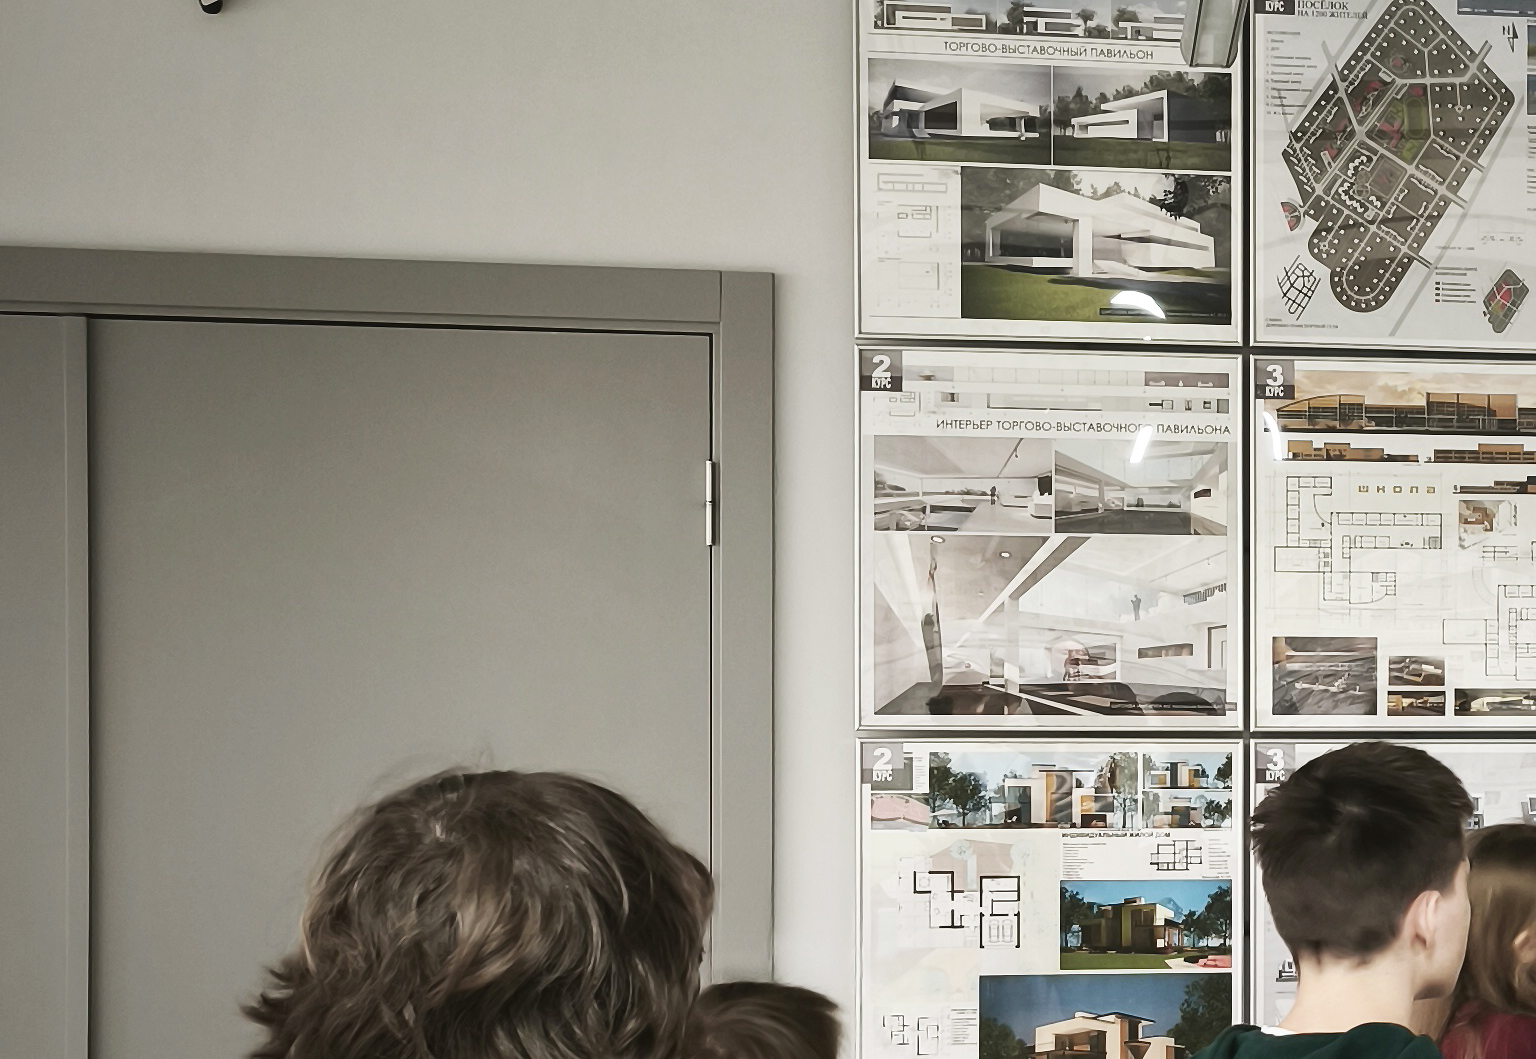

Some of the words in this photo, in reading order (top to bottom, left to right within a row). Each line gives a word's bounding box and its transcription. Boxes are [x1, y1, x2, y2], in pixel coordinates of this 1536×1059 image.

[943, 41, 1087, 57] ТОРГОВО-ВЫСТАВОЧНЫЙ
[1090, 47, 1154, 60] ПАВИЛЬОН
[871, 354, 892, 378] 2
[1266, 364, 1284, 386] 3
[871, 377, 892, 389] КУРС
[1265, 386, 1285, 397] КУРС
[936, 418, 993, 431] ИНТЕРЬЕР
[996, 419, 1152, 434] ТОРГОВО-ВЫСТАВОЧНОГ
[1156, 423, 1231, 436] ПАВИЛЬОНА
[872, 747, 893, 770] 2
[1266, 748, 1285, 770] 3
[872, 770, 893, 782] КУРС
[1265, 770, 1286, 781] КУРС
